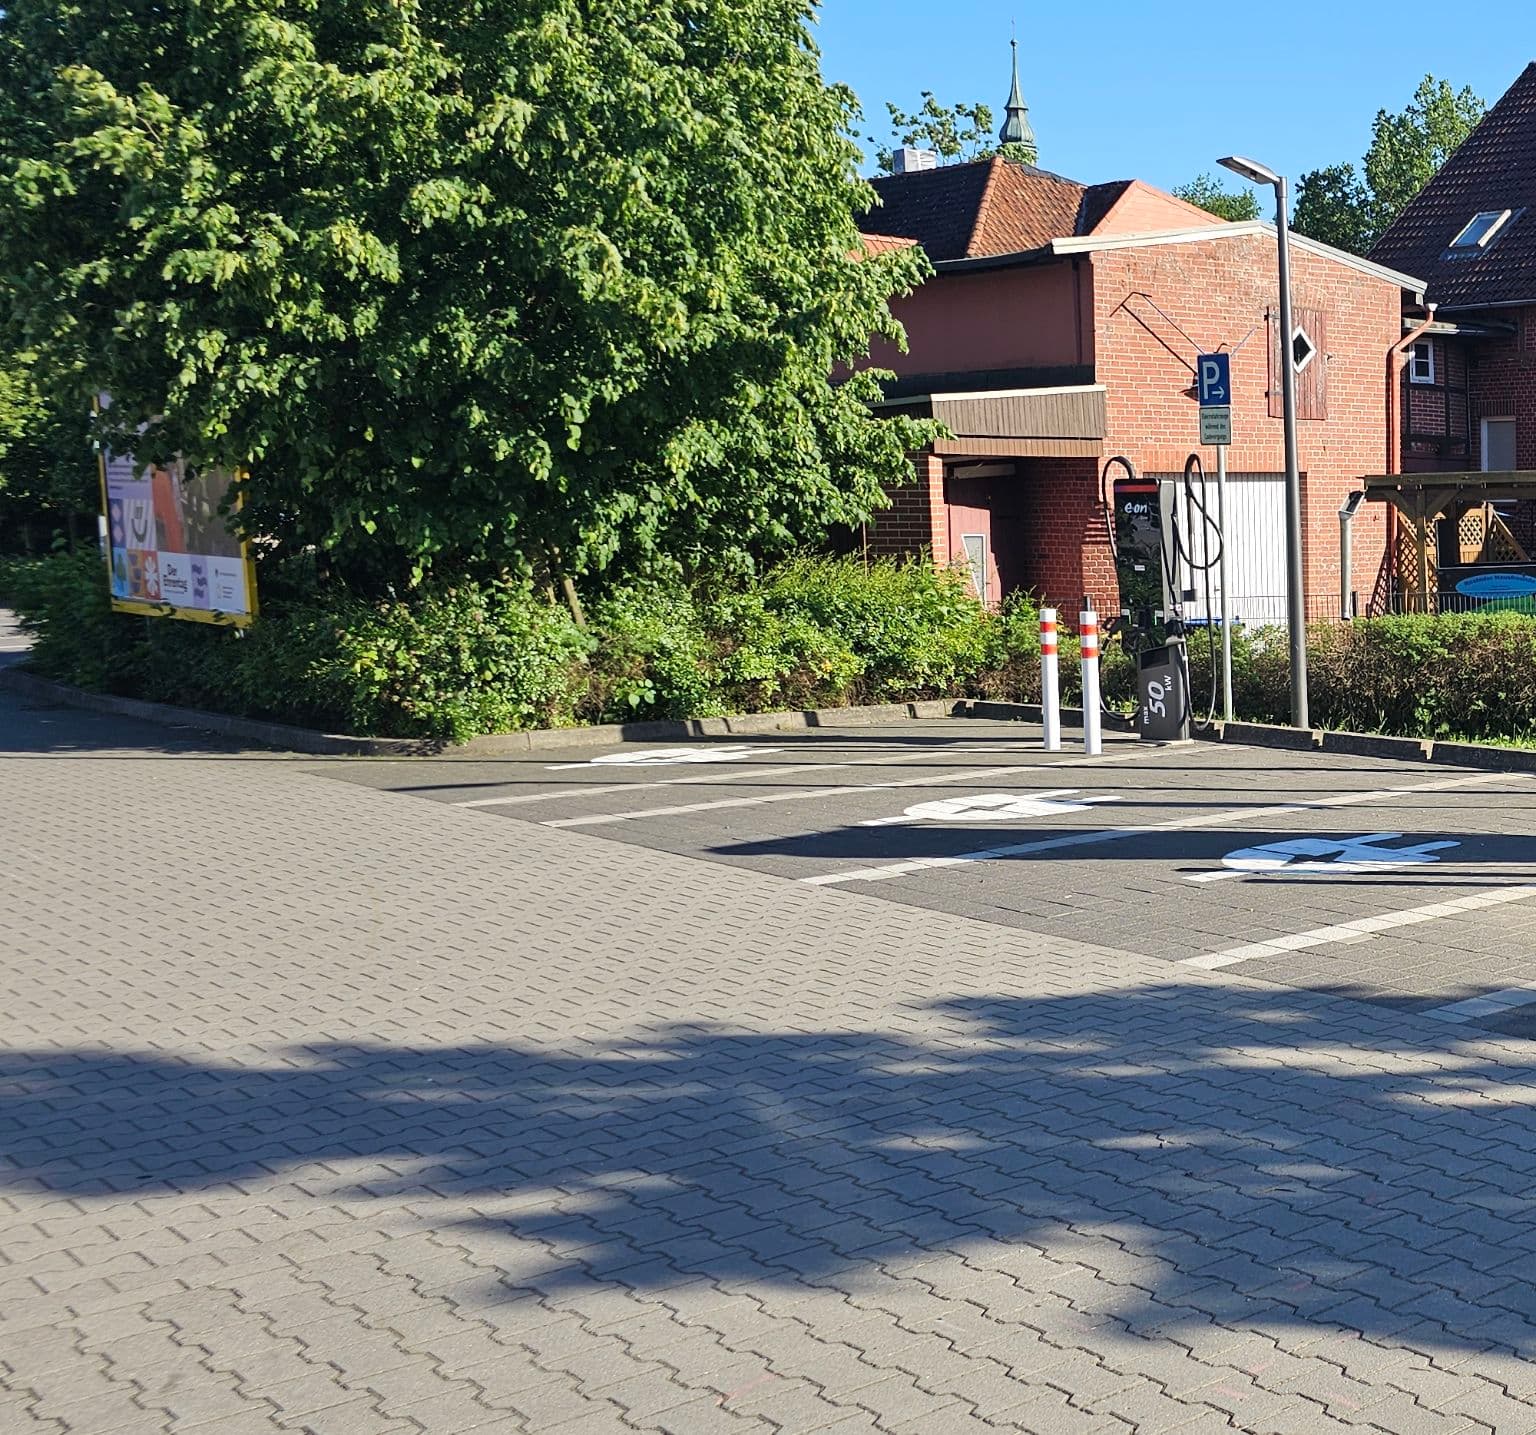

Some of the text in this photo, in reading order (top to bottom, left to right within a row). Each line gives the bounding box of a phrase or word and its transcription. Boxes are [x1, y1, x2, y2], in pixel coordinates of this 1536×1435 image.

[1202, 361, 1220, 400] P
[1148, 681, 1166, 718] 50
[1164, 675, 1173, 691] kW
